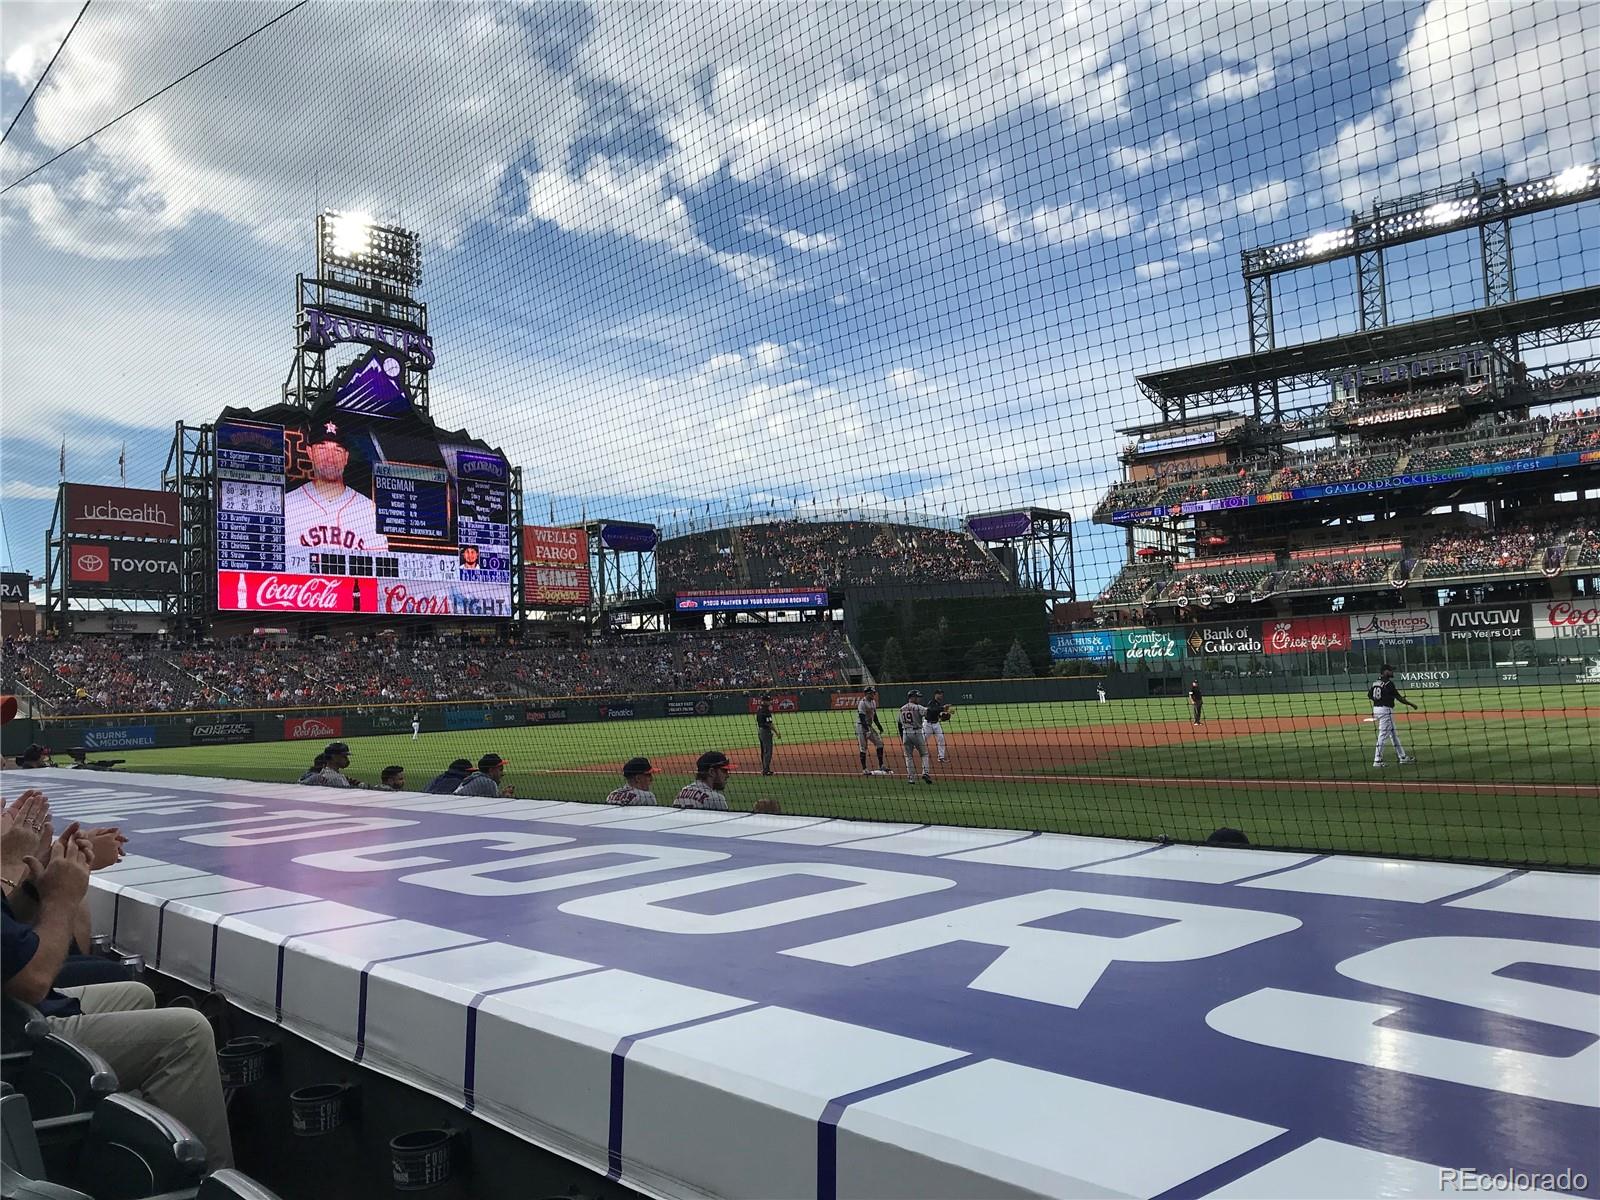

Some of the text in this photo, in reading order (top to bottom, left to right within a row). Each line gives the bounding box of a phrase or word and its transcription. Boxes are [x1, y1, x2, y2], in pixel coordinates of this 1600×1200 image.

[306, 309, 435, 369] ROCKIES
[1357, 405, 1447, 427] SMASHBURGER
[462, 460, 503, 477] COLORADO
[376, 476, 415, 492] BREGMAN
[1256, 490, 1294, 505] SUMMERFEST
[83, 500, 167, 524] uchealth
[300, 525, 365, 551] ASTROS
[534, 529, 577, 545] WELLS
[230, 550, 245, 558] Straw
[535, 545, 578, 560] FARGO
[111, 557, 179, 574] TOYOTA
[536, 569, 579, 587] KING
[256, 578, 343, 608] Coca-Cola
[385, 584, 449, 615] Coors
[1450, 609, 1520, 628] ARROW
[1547, 602, 1600, 626] Coo
[1092, 634, 1103, 646] &
[1128, 631, 1171, 644] Comfort
[1203, 625, 1249, 641] Bank of
[1272, 628, 1342, 650] Chick-fil-A
[1451, 627, 1521, 639] Five Years Out
[1126, 640, 1175, 659] dental
[1204, 637, 1262, 653] Colorado
[1400, 670, 1450, 681] MARSICO
[1410, 681, 1440, 689] FUNDS
[608, 708, 634, 718] Fanatics
[902, 711, 913, 724] 19
[95, 730, 127, 740] BURNS
[212, 728, 252, 736] NERVE
[214, 723, 246, 731] OPTIC
[293, 724, 334, 738] Red Robin
[291, 830, 1600, 1107] COORS
